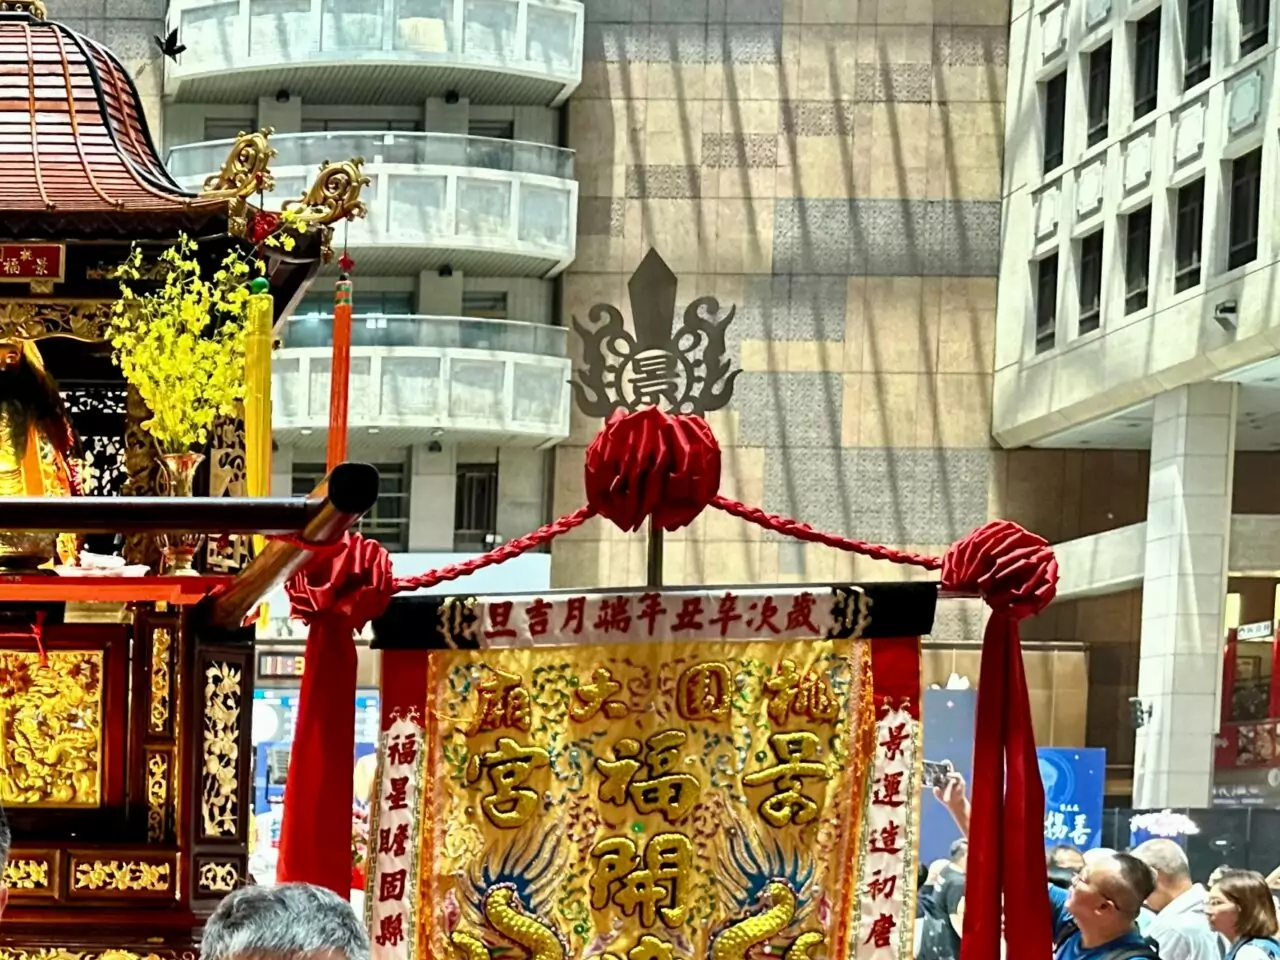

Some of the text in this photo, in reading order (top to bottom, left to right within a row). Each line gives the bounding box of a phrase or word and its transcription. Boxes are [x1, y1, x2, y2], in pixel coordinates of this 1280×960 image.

[483, 589, 822, 640] 歲次辛丑年端月吉旦
[472, 658, 840, 735] 桃園大廟
[467, 728, 827, 829] 景福宮
